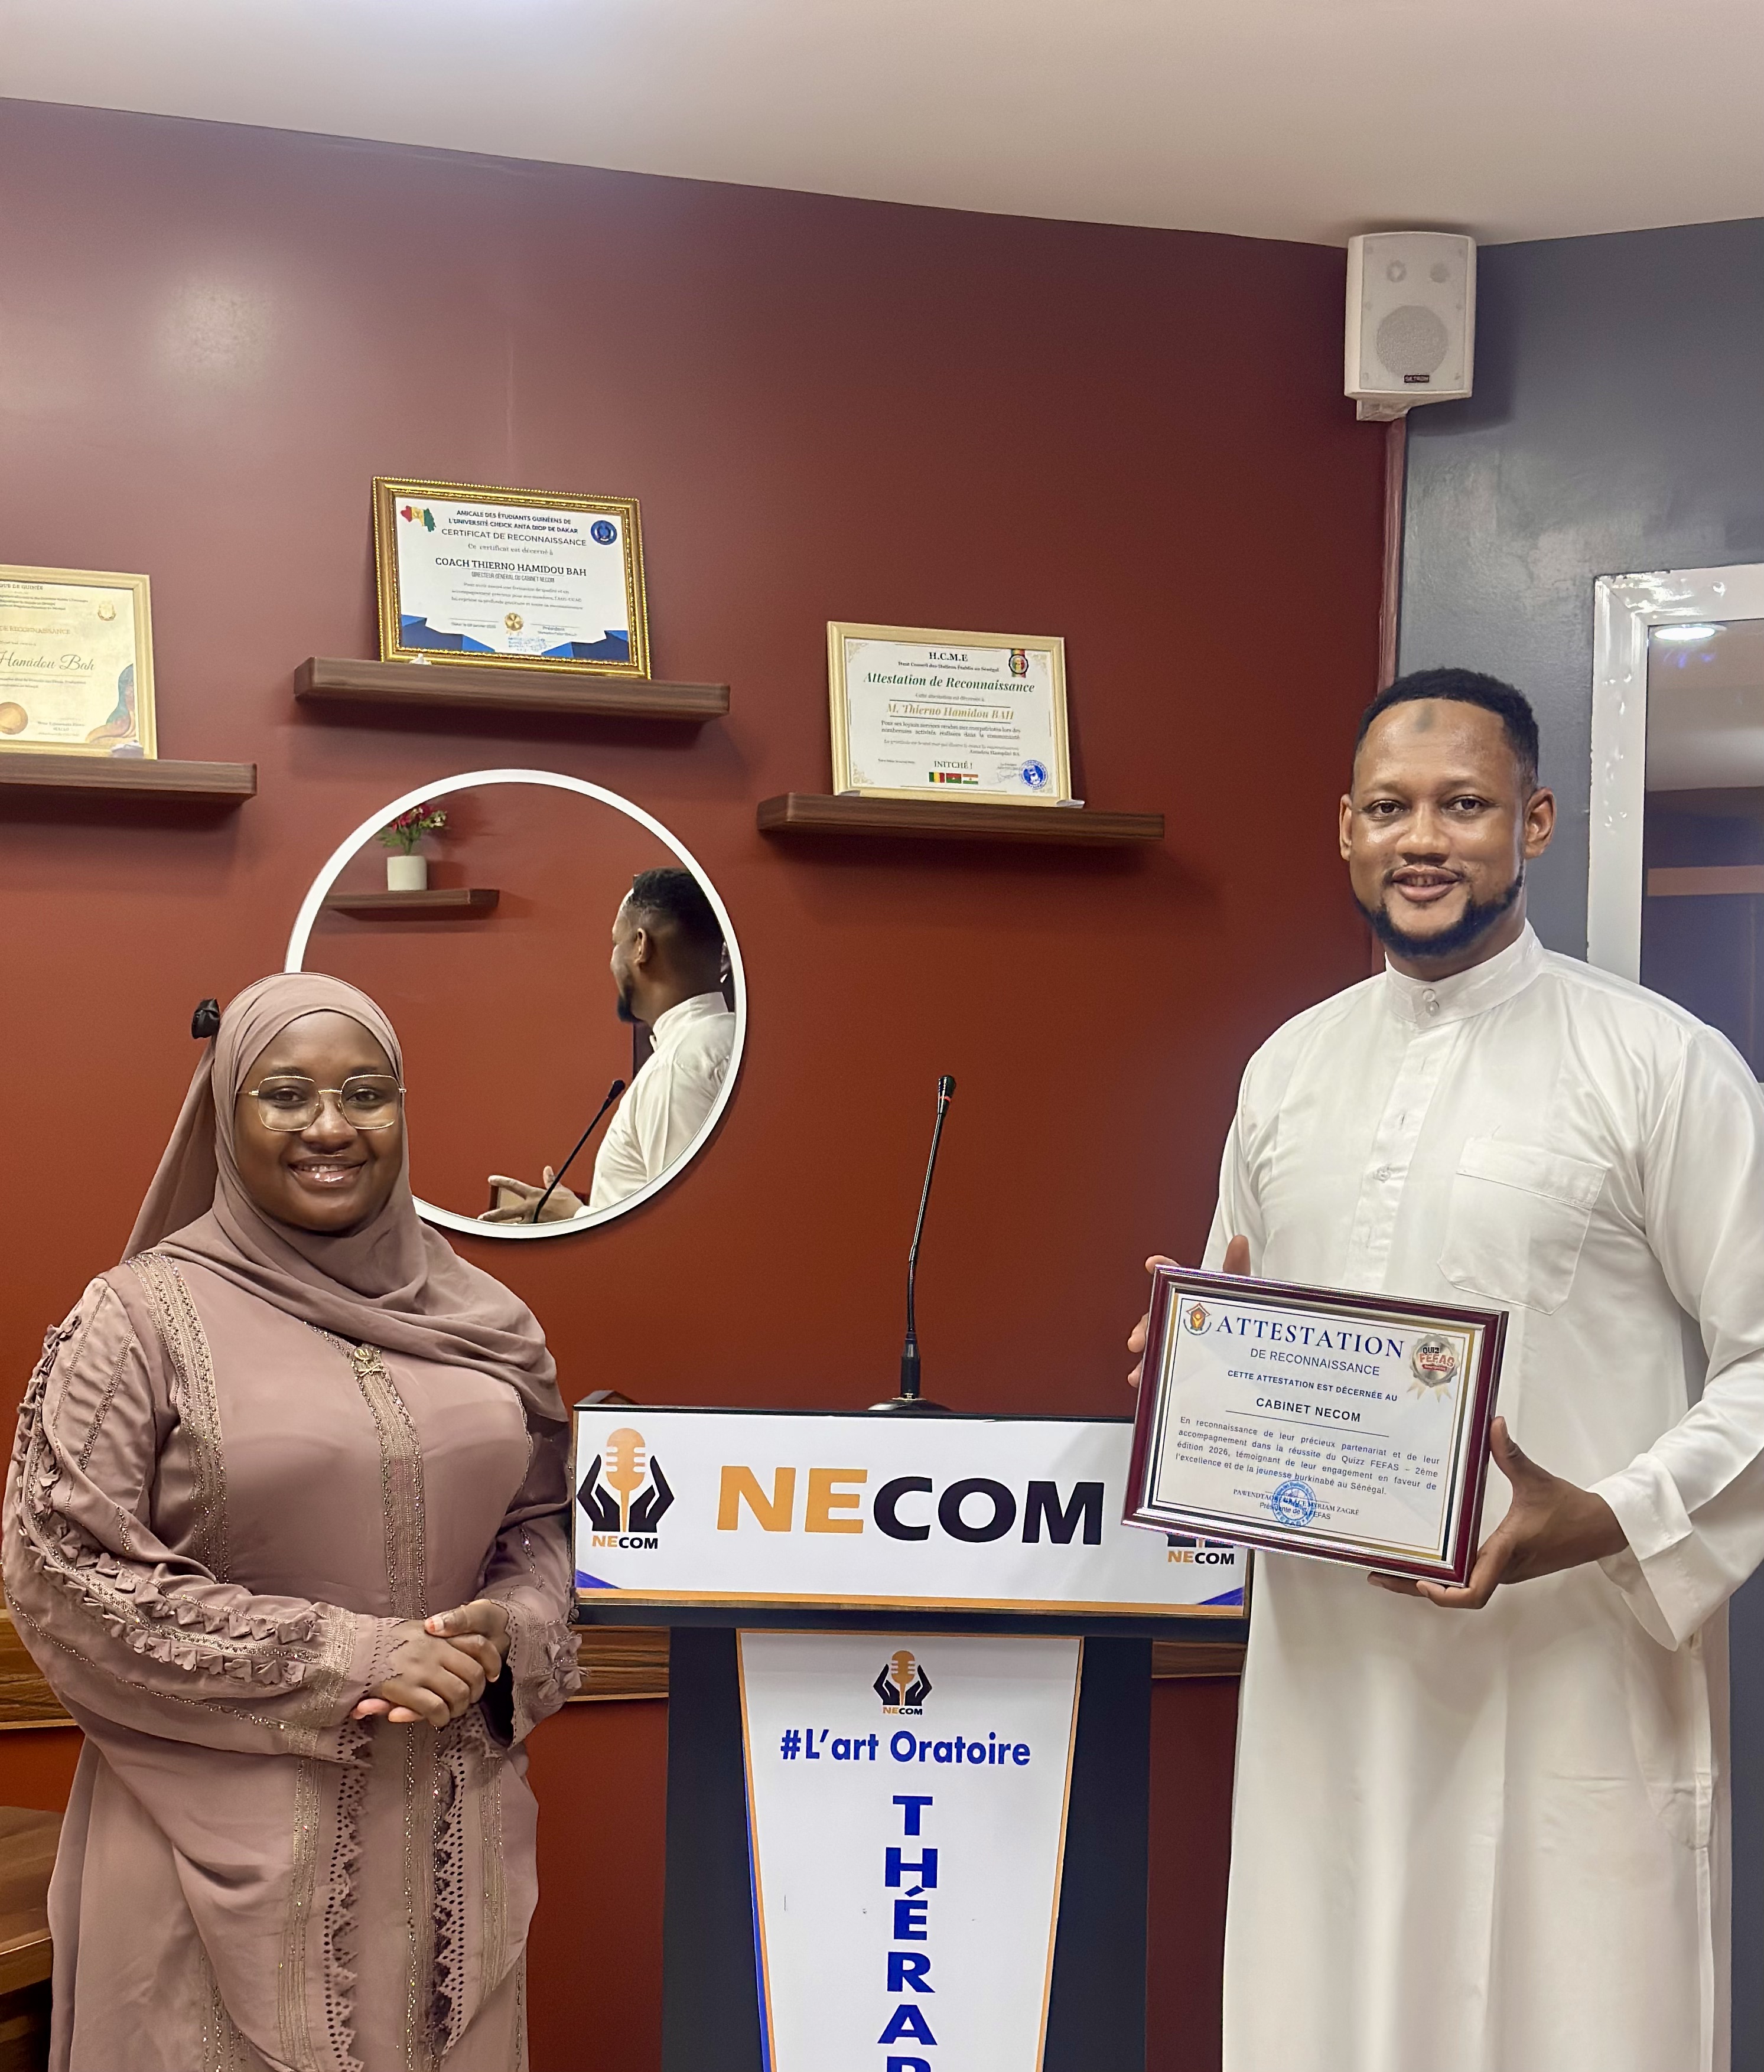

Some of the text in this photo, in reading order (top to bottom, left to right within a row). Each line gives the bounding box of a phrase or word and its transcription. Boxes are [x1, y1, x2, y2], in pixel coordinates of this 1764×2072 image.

[498, 512, 530, 522] ÉTUDIANTS
[442, 529, 490, 538] CERTIFICAT
[507, 533, 587, 546] RECONNAISSANCE
[435, 558, 470, 568] COACH
[472, 561, 515, 571] THIERNO
[517, 563, 564, 574] HAMIDOU
[0, 651, 94, 670] Hamidou Bah
[929, 652, 968, 662] H.C.M.E
[864, 672, 1034, 692] Attestation de Reconnaissance
[887, 703, 1014, 721] M. Thierno Hamidou BAH
[934, 760, 968, 769] INITCHÉ
[1215, 1315, 1405, 1359] ATTESTATION
[1423, 1347, 1440, 1355] QUIZ
[1251, 1348, 1381, 1376] DE RECONNAISSANCE
[1228, 1370, 1397, 1402] CETTE ATTESTATION EST DÉCERNÉE AU
[1256, 1397, 1361, 1422] CABINET NECOM
[1180, 1416, 1190, 1425] En
[1196, 1420, 1258, 1435] reconnaissance
[1280, 1432, 1295, 1441] leur
[1301, 1436, 1335, 1448] précieux
[1341, 1443, 1387, 1456] partenariat
[1424, 1455, 1440, 1464] leur
[1179, 1430, 1247, 1447] accompagnement
[1252, 1441, 1271, 1450] dans
[1276, 1444, 1283, 1452] la
[1289, 1447, 1320, 1458] réussite
[1342, 1455, 1365, 1465] Quizz
[1371, 1460, 1399, 1471] FEFAS
[1415, 1467, 1438, 1477] 2ème
[1176, 1452, 1222, 1467] l'excellence
[1256, 1466, 1292, 1479] jeunesse
[1350, 1482, 1387, 1494] Sénégal.
[1177, 1441, 1203, 1451] édition
[1209, 1447, 1231, 1457] 2026,
[1236, 1451, 1280, 1464] témoignant
[1301, 1461, 1317, 1470] leur
[1322, 1465, 1372, 1480] engagement
[1394, 1477, 1420, 1487] faveur
[717, 1465, 1104, 1546] NECOM
[1336, 1506, 1359, 1516] ZAGRÉ
[592, 1536, 658, 1549] NECOM
[1168, 1551, 1234, 1565] NECOM
[890, 1731, 1030, 1765] Oratoire
